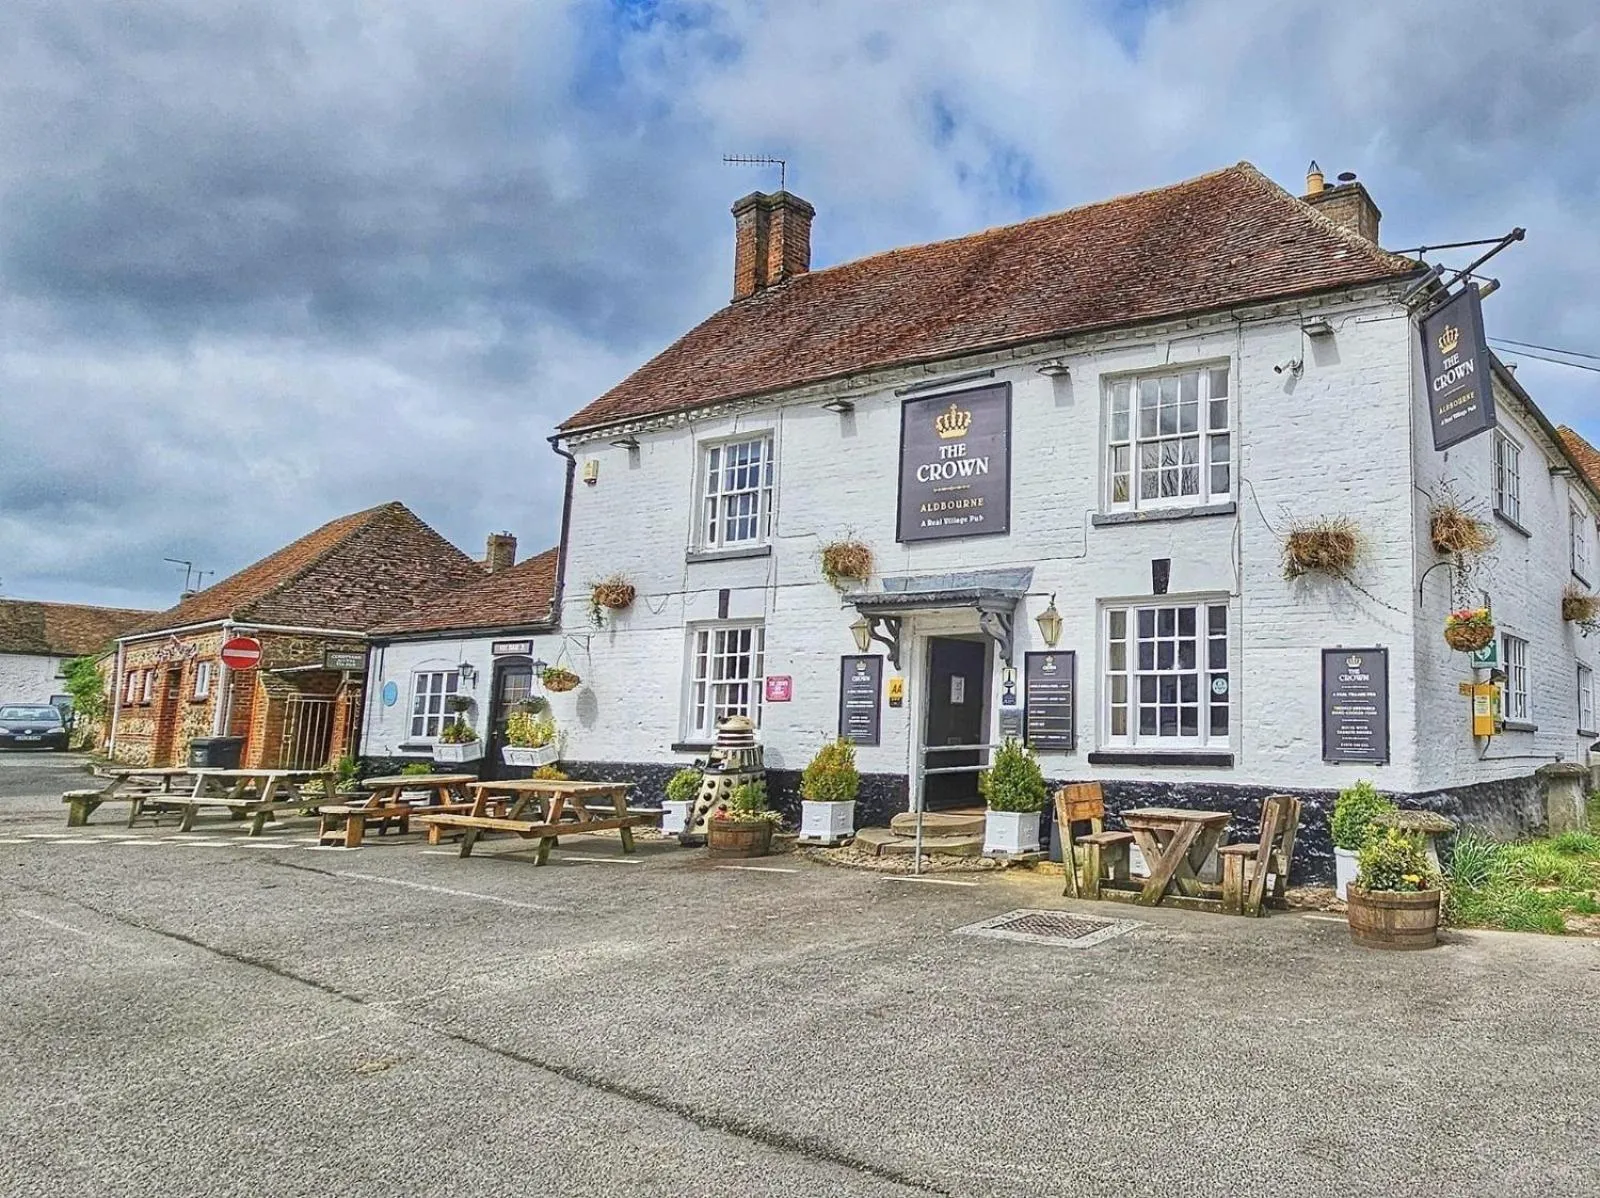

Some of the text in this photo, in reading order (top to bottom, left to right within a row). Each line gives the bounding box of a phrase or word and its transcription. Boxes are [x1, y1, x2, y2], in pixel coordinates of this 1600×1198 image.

[1443, 352, 1459, 371] THE
[1433, 358, 1475, 392] CROWN
[1438, 391, 1475, 415] ALDBOURNE
[939, 443, 967, 460] THE
[916, 457, 989, 483] CROWN
[920, 497, 984, 512] ALDBOURNE
[927, 518, 942, 526] Real
[943, 516, 969, 525] Village
[969, 514, 984, 522] Pub
[1338, 674, 1370, 682] CROWN
[891, 684, 903, 694] AA
